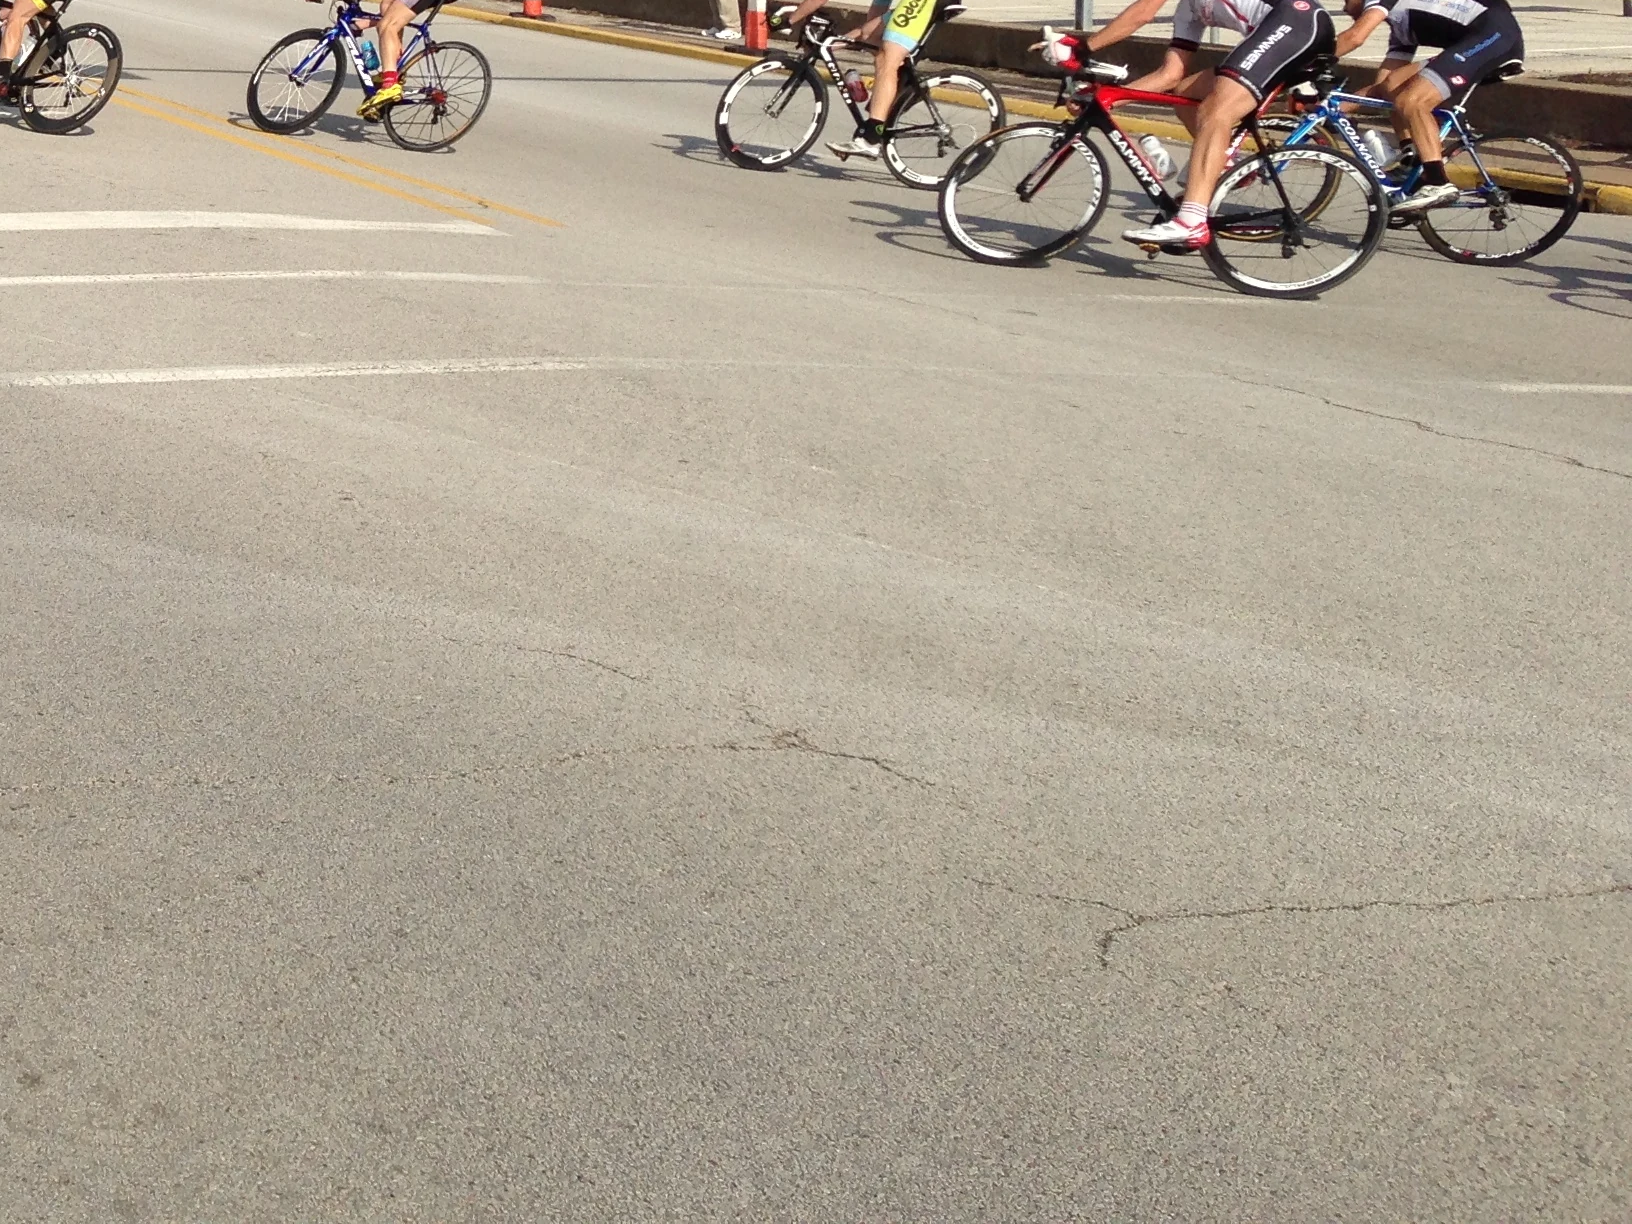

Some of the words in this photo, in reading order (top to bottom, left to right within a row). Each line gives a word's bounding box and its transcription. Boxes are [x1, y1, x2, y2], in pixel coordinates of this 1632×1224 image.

[1108, 129, 1164, 197] SAMMY'S
[1223, 150, 1359, 190] REYNODS
[1339, 118, 1387, 179] COLNAGO
